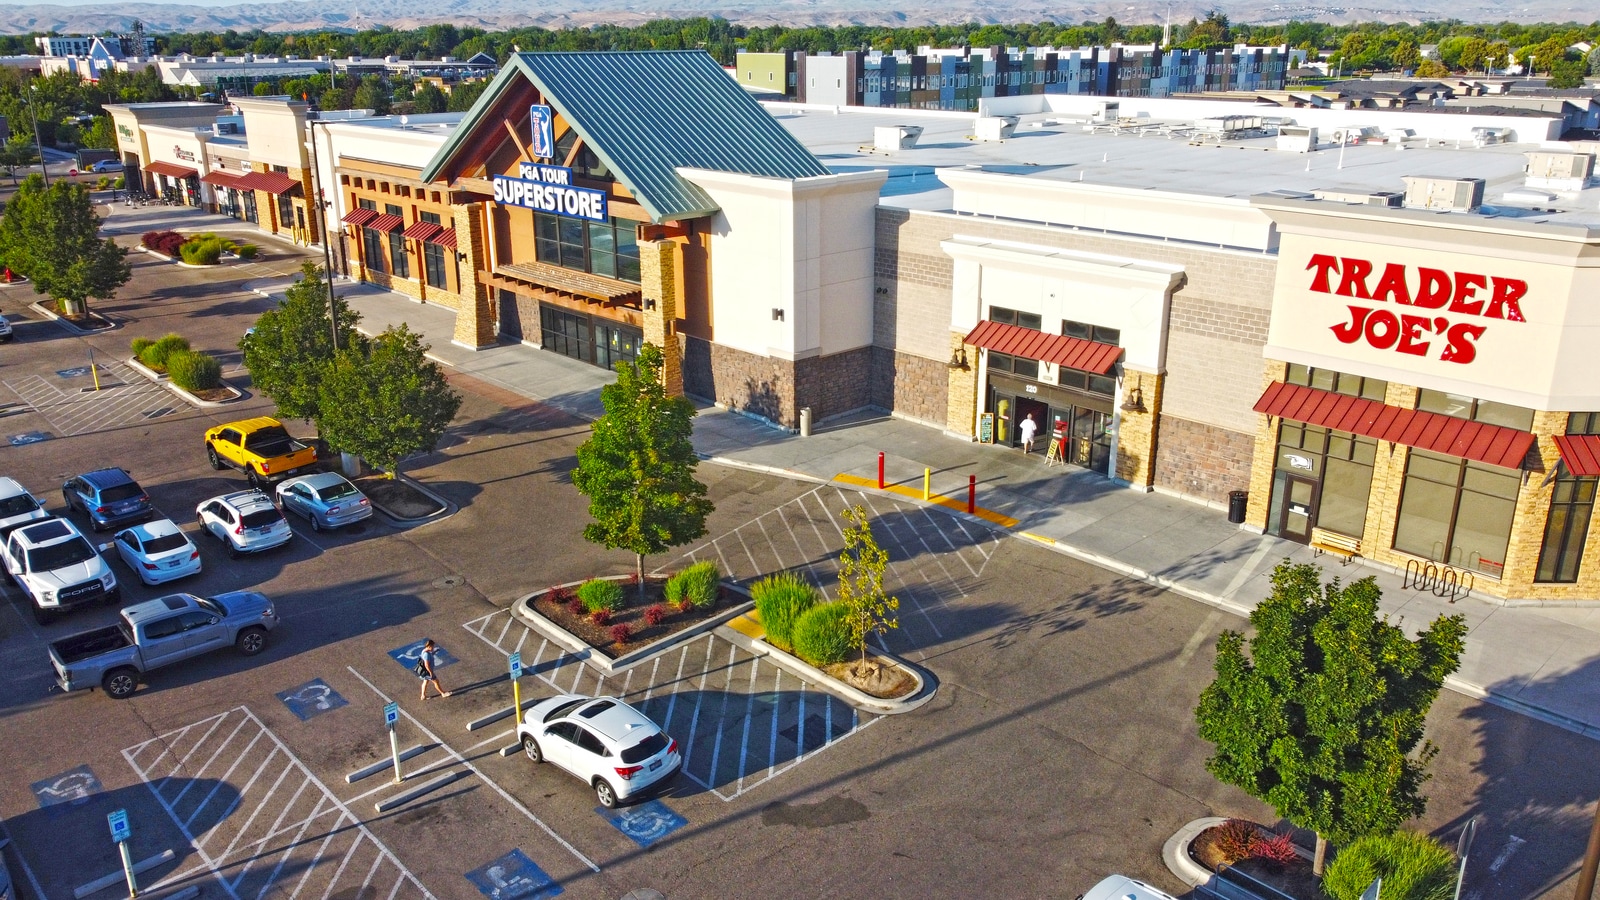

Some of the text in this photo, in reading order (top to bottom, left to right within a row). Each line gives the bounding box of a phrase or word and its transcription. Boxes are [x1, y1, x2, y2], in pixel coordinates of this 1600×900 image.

[519, 165, 568, 185] PGA TOUR
[493, 178, 603, 220] SUPERSTORE
[1305, 253, 1528, 323] TRADER
[1328, 305, 1488, 365] JOE'S
[60, 583, 101, 598] FORD
